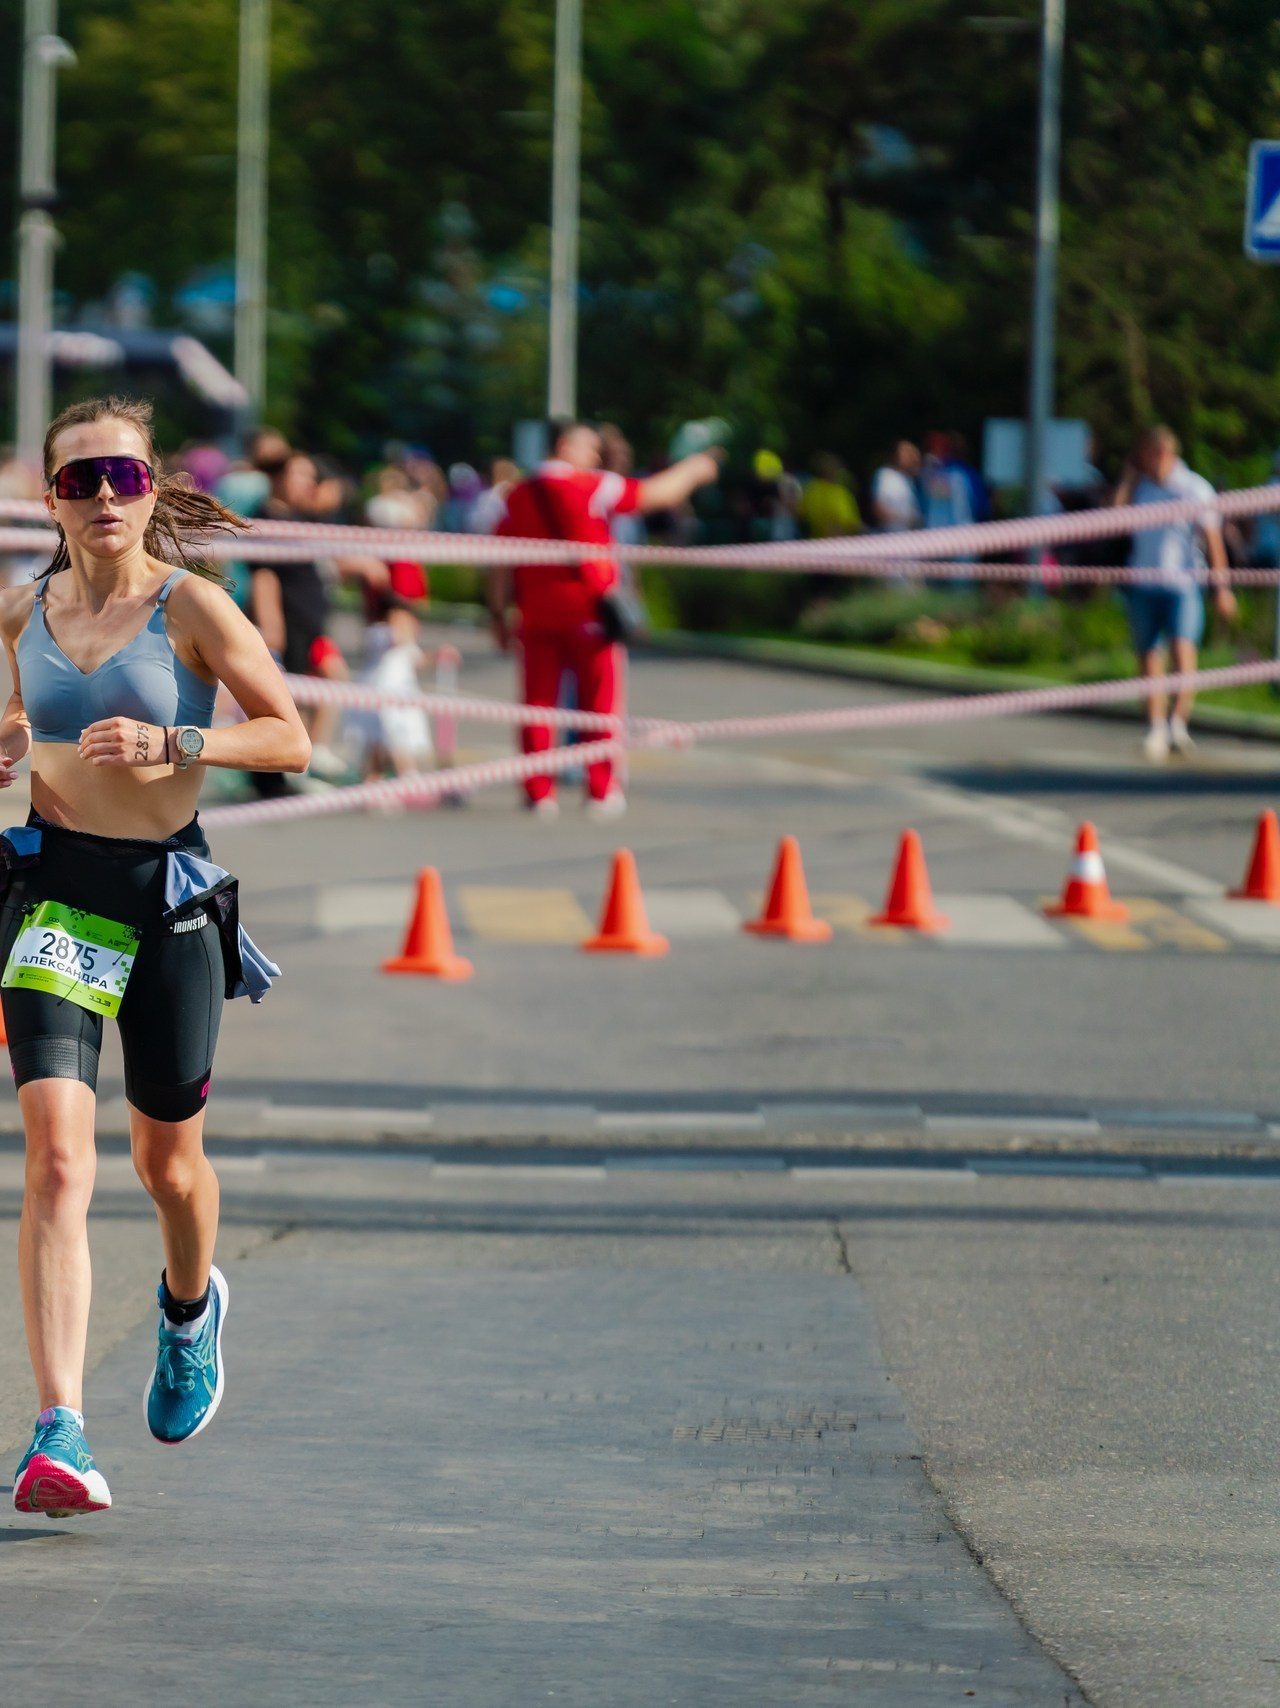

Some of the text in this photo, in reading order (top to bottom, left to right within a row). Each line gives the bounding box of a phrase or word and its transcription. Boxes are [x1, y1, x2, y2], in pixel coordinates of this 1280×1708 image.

[134, 723, 150, 761] 2875
[39, 931, 98, 971] 2875
[20, 955, 108, 989] АЛЕКСАНДРА
